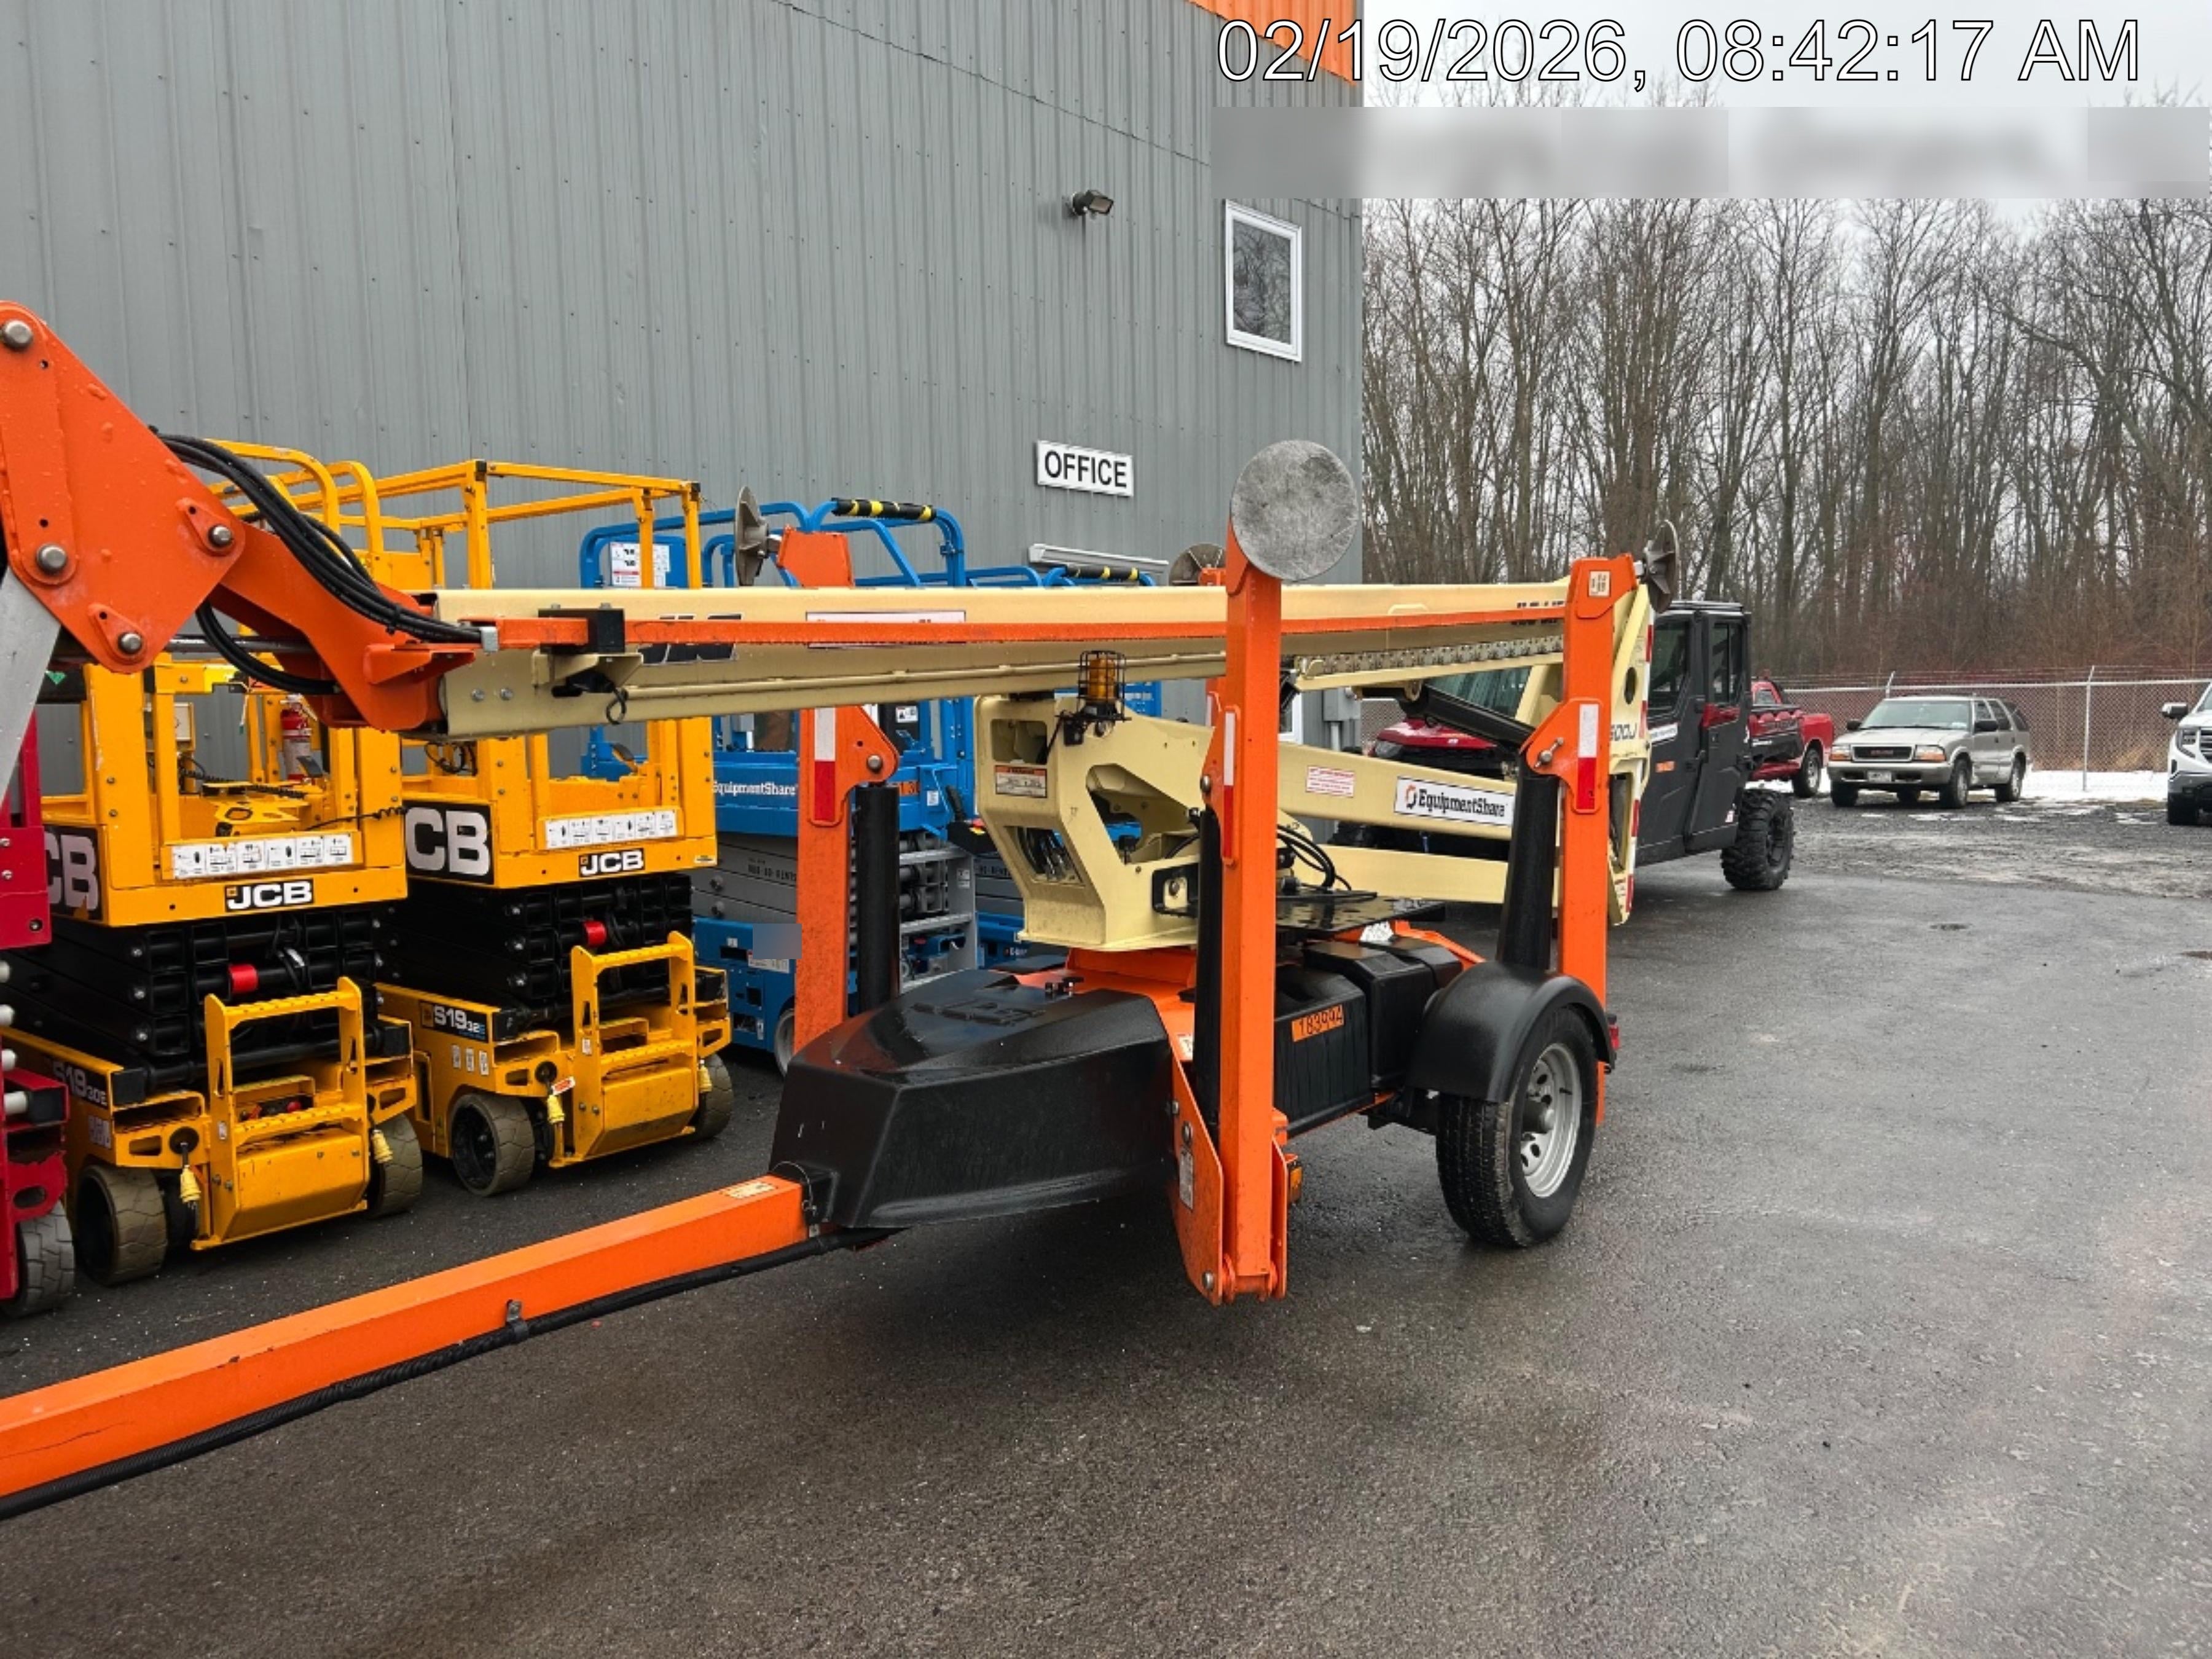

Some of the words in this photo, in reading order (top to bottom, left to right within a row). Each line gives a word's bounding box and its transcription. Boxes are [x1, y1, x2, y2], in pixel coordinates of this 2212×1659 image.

[1045, 450, 1127, 488] OFFICE
[1419, 788, 1505, 817] EquipmentShare
[581, 849, 644, 876] JCB
[227, 880, 313, 910] JCB
